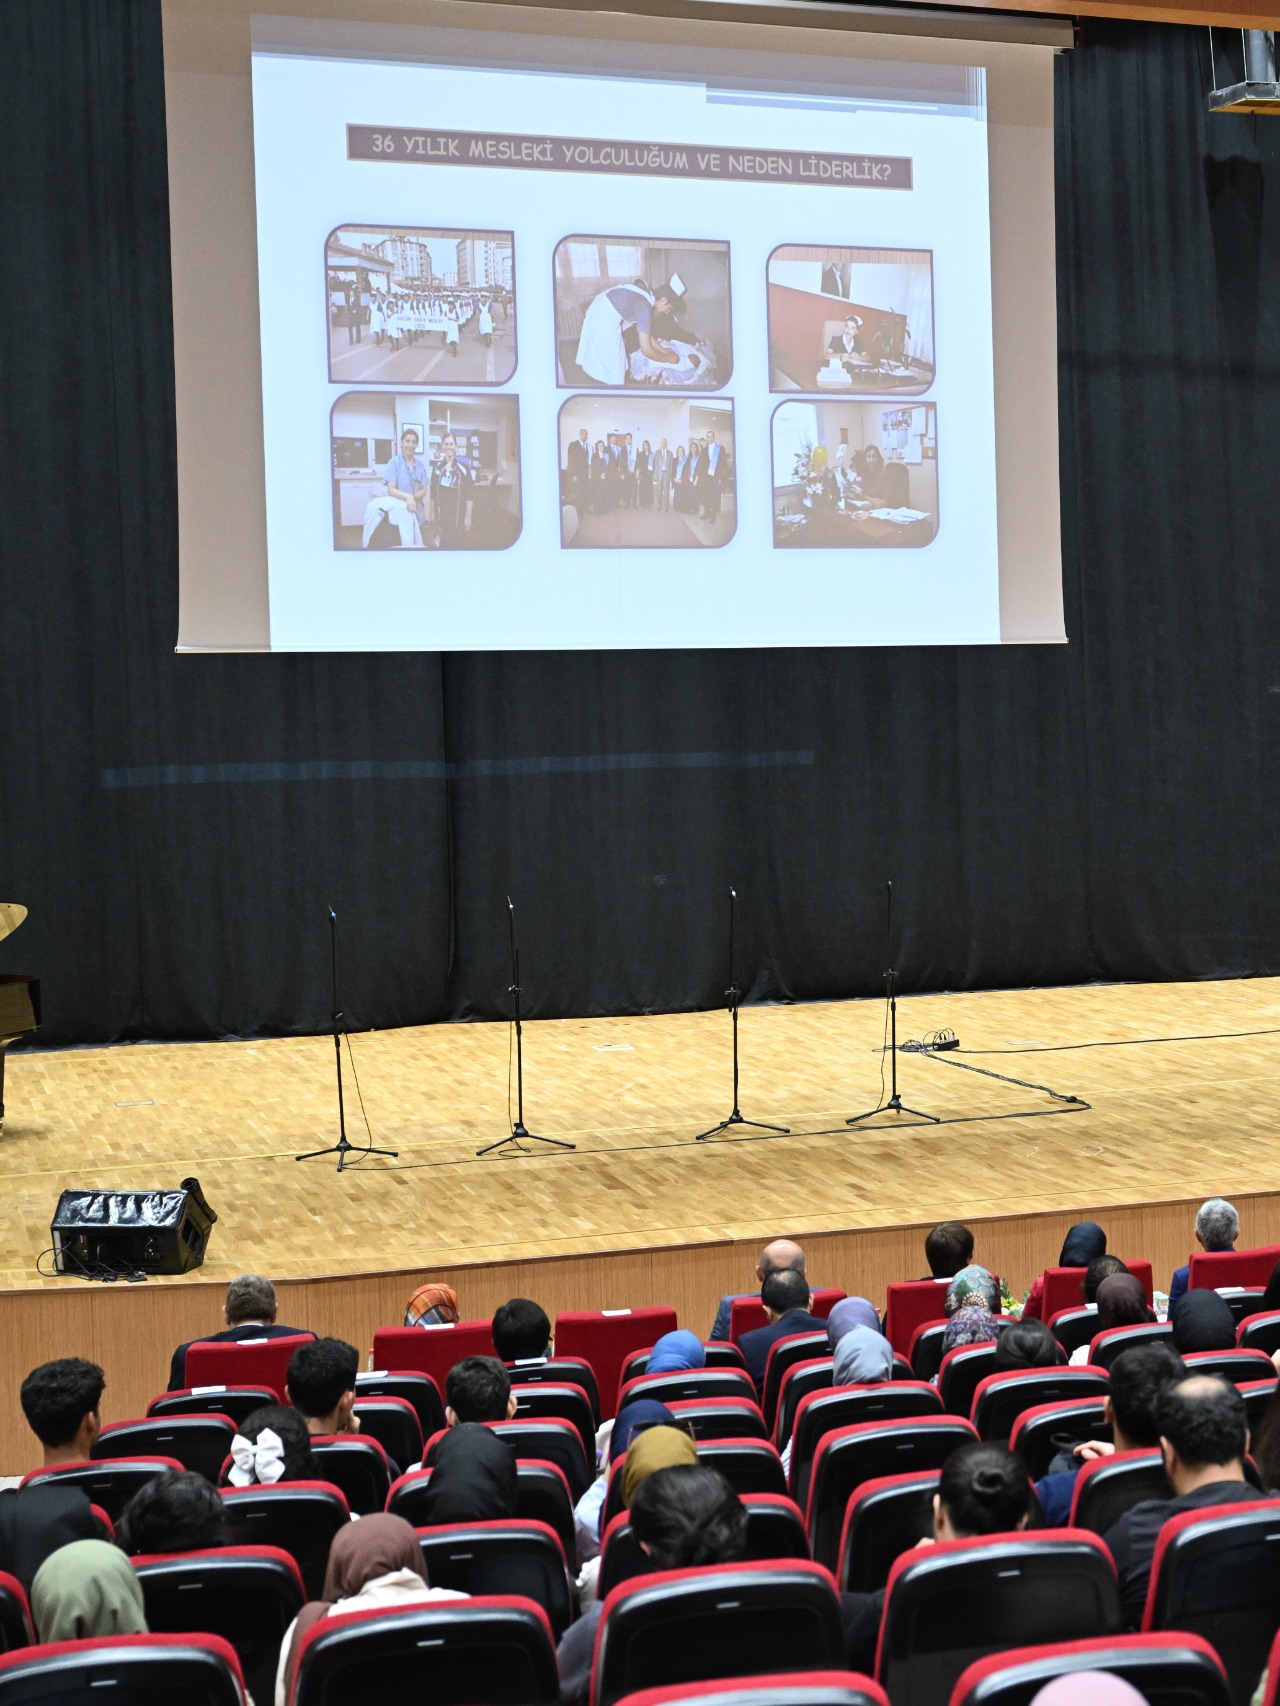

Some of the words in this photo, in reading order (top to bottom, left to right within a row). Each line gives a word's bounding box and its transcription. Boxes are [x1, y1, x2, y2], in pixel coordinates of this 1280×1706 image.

[372, 134, 395, 153] 36
[402, 135, 460, 157] YILIK
[469, 139, 554, 162] MESLEKİ
[561, 144, 689, 170] YOLCULUĞUM
[696, 153, 721, 173] VE
[728, 154, 793, 175] NEDEN
[800, 155, 892, 181] LİDERLİK?
